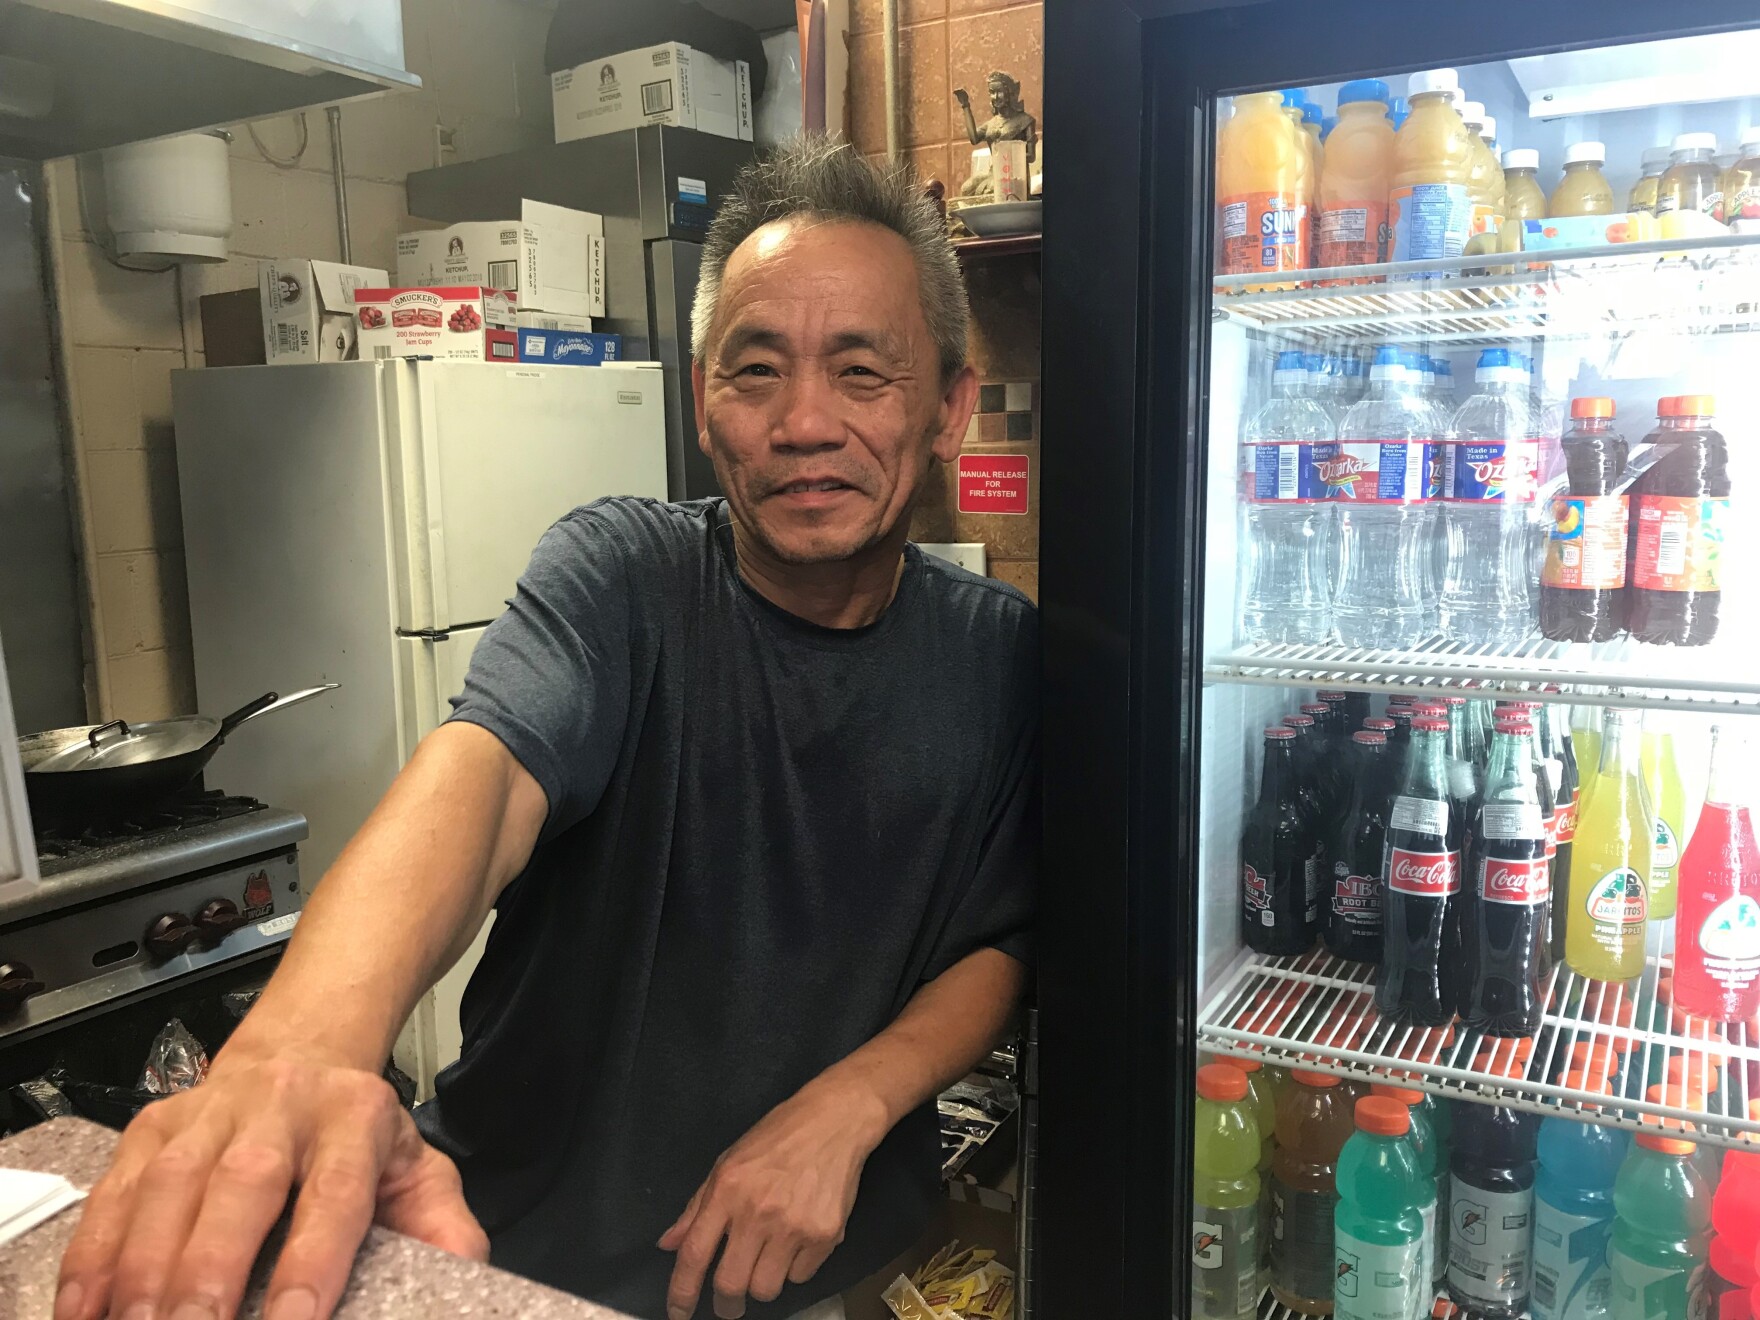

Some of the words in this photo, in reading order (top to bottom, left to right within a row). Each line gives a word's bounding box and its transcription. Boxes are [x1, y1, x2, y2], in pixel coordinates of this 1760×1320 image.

[394, 294, 439, 306] SMUCKER'S
[300, 330, 309, 346] Salt
[557, 343, 594, 356] Mayonnaise
[960, 470, 992, 478] MANUAL
[992, 471, 1027, 479] RELEASE
[1319, 458, 1363, 482] Ozarka
[985, 480, 1001, 488] FOR
[969, 489, 986, 497] FIRE
[987, 490, 1017, 498] SYSTEM
[1342, 898, 1367, 907] ROOT
[247, 905, 272, 919] WOLF
[1597, 904, 1641, 916] JARITOS
